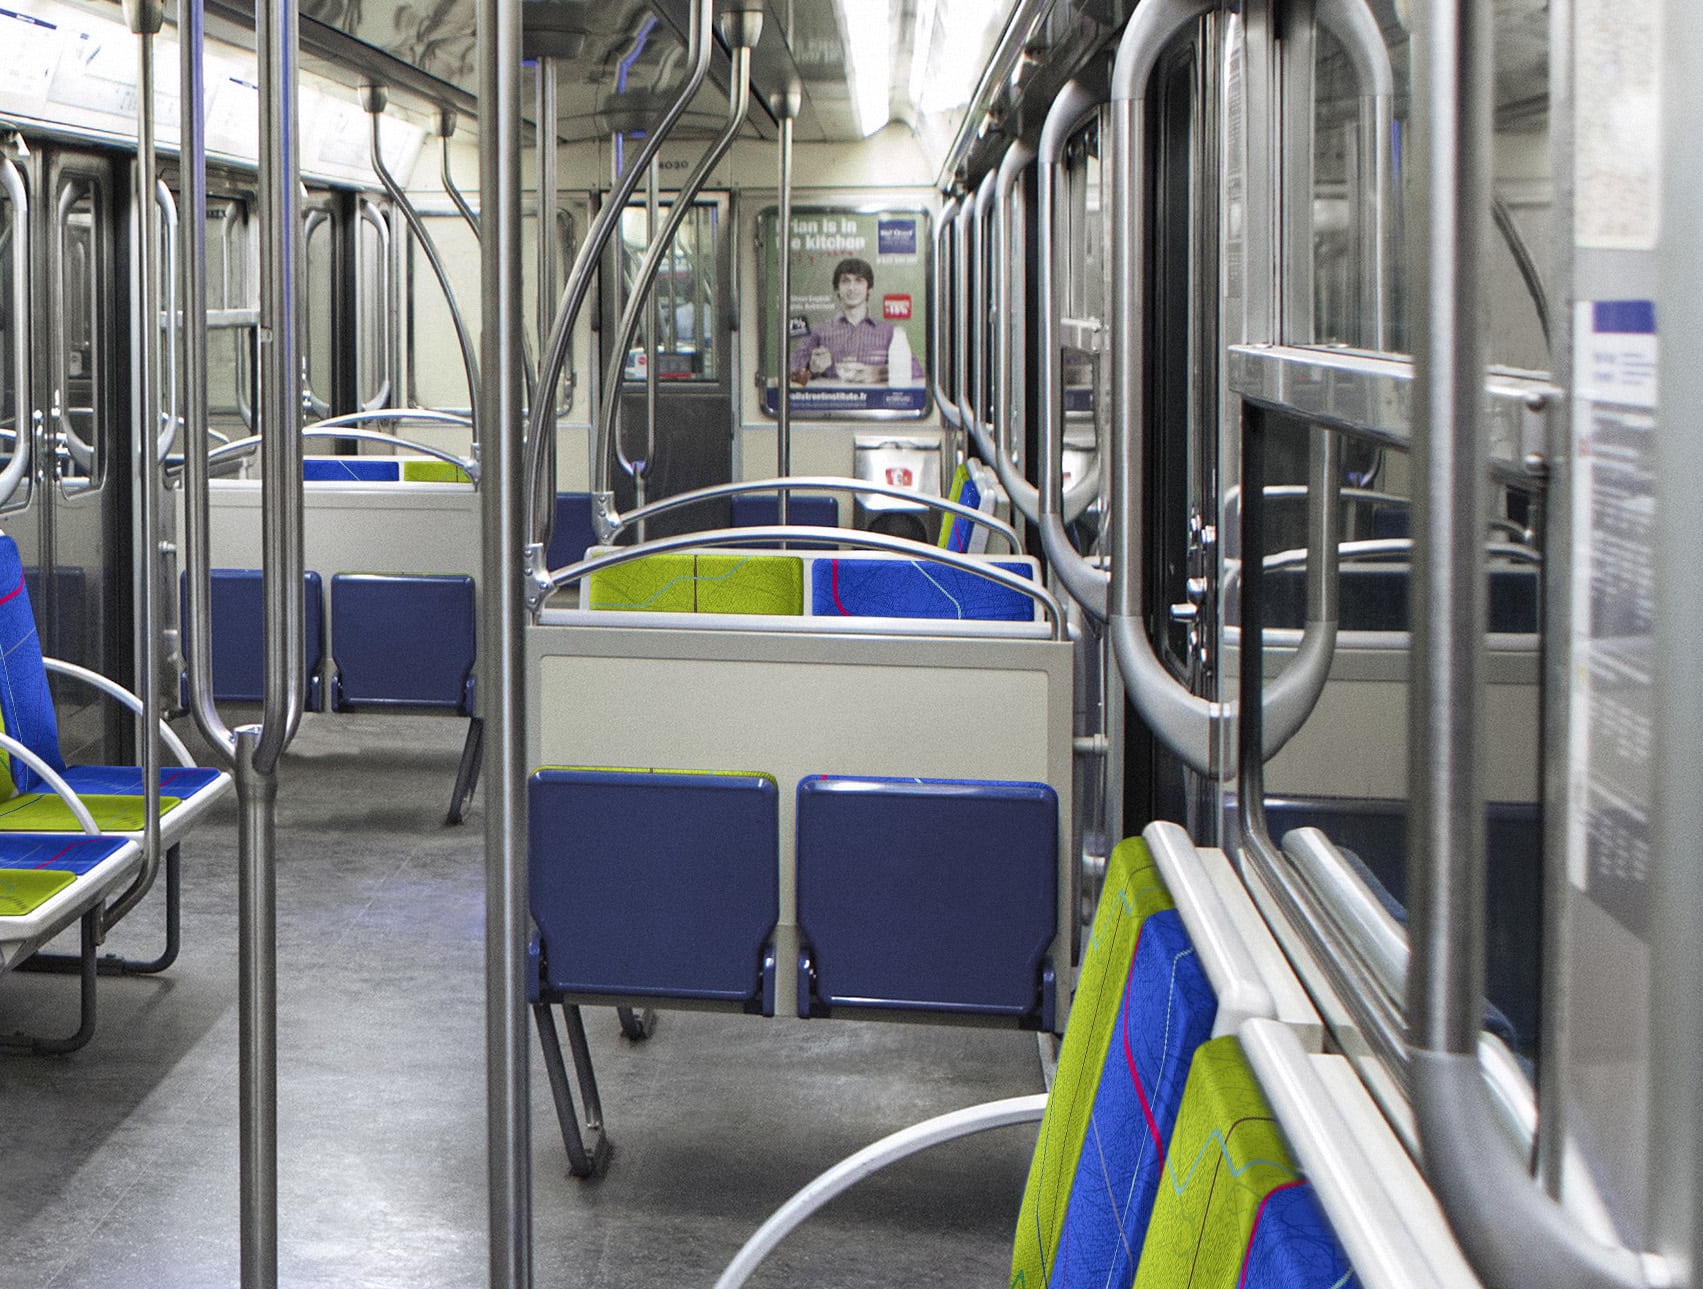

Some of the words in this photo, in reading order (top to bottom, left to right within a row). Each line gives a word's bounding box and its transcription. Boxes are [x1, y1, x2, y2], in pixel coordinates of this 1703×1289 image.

[776, 218, 818, 233] ian
[823, 218, 837, 233] is
[841, 218, 857, 233] in
[805, 234, 866, 249] kitchen
